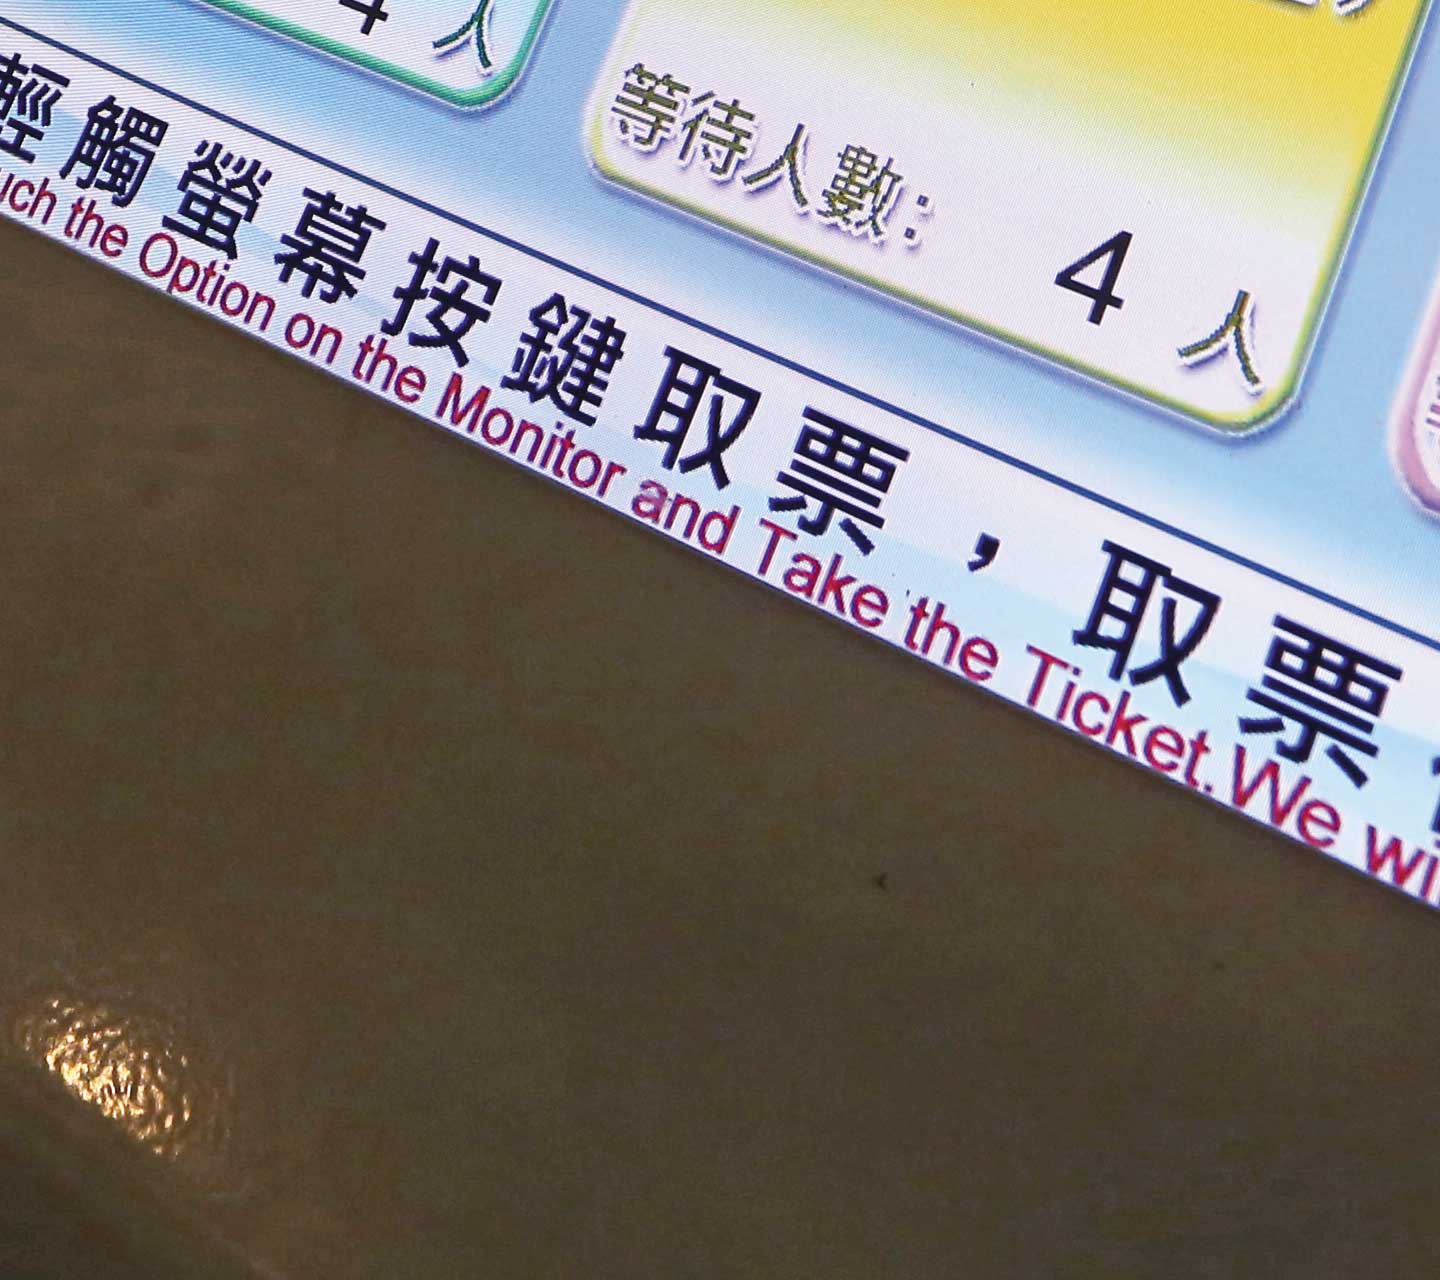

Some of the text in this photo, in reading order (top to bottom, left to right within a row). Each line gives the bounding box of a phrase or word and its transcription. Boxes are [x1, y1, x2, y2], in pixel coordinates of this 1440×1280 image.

[68, 196, 130, 260] the
[137, 231, 277, 332] Option
[283, 309, 344, 366] on
[358, 336, 427, 407] the
[434, 371, 627, 502] Monitor
[630, 473, 743, 557] and
[754, 516, 890, 629] Take
[901, 592, 1001, 684] the
[1053, 229, 1133, 325] 4
[1175, 289, 1264, 396] 人
